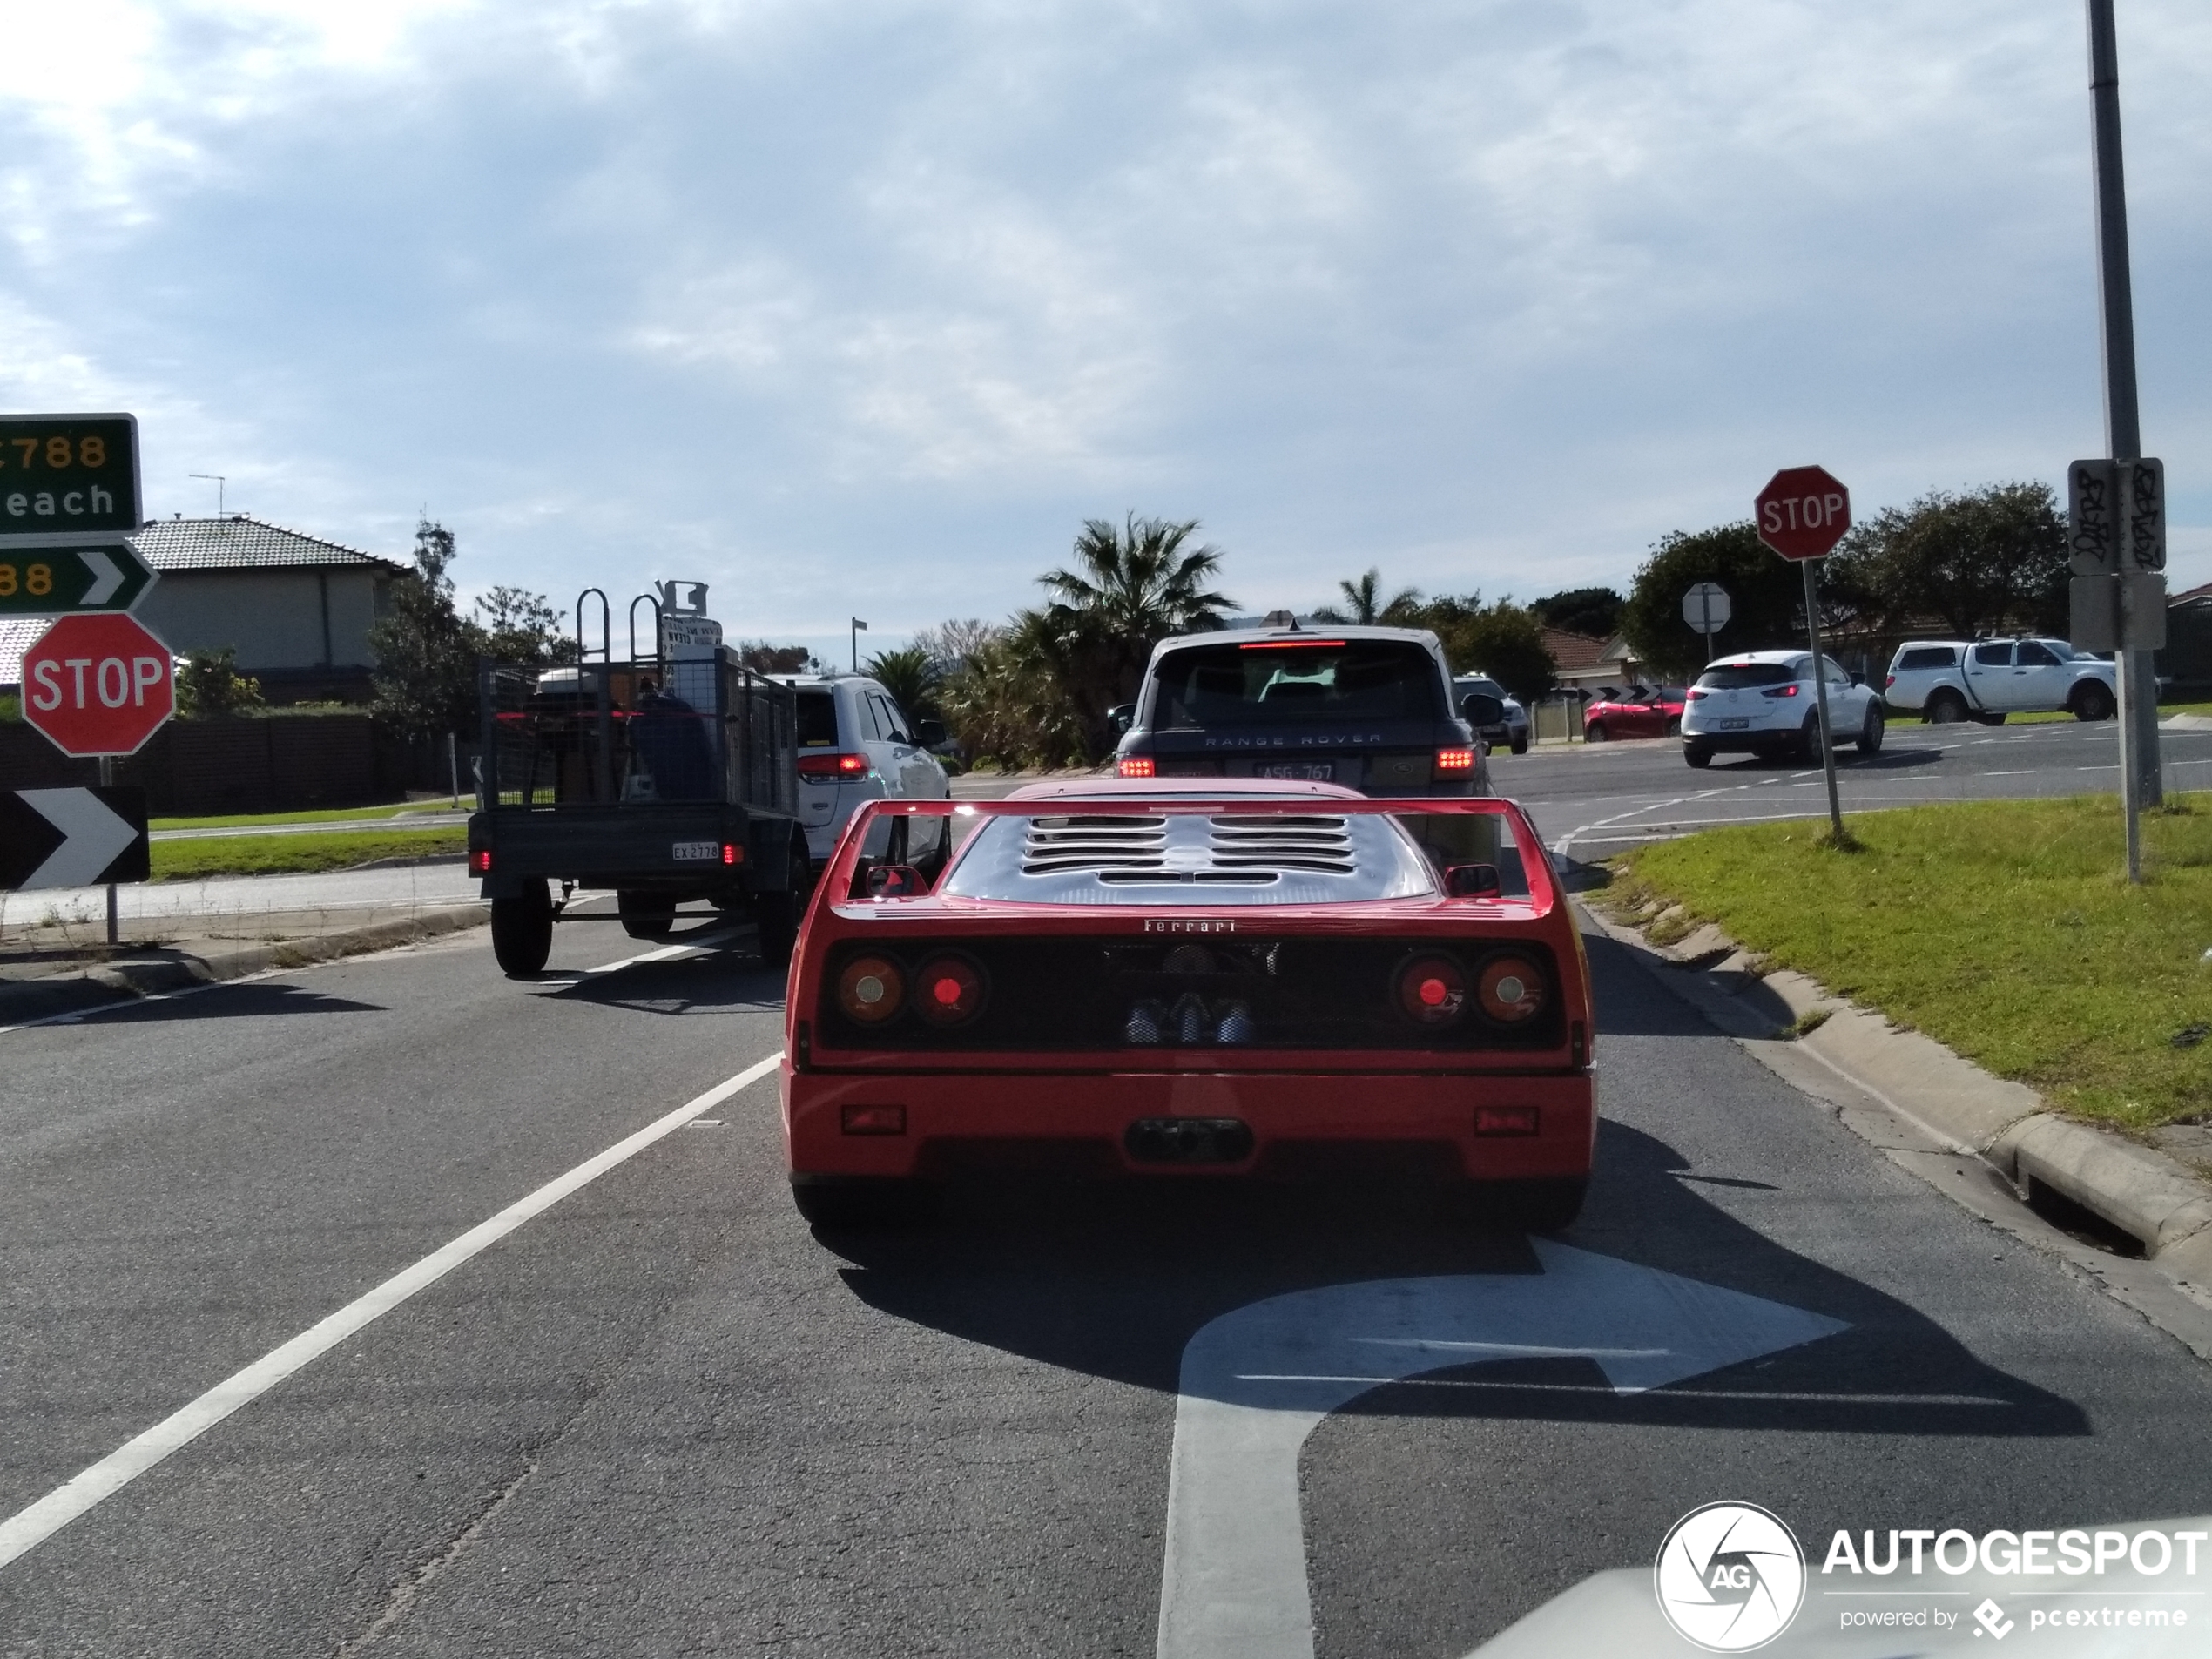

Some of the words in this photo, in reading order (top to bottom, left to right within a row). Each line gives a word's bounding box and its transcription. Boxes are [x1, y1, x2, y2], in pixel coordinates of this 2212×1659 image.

[6, 484, 113, 516] each
[1764, 493, 1843, 534] STOP
[32, 657, 163, 711] STOP
[1205, 737, 1284, 746] RANGE
[1301, 734, 1381, 745] ROVER
[1143, 919, 1235, 932] Ferrari
